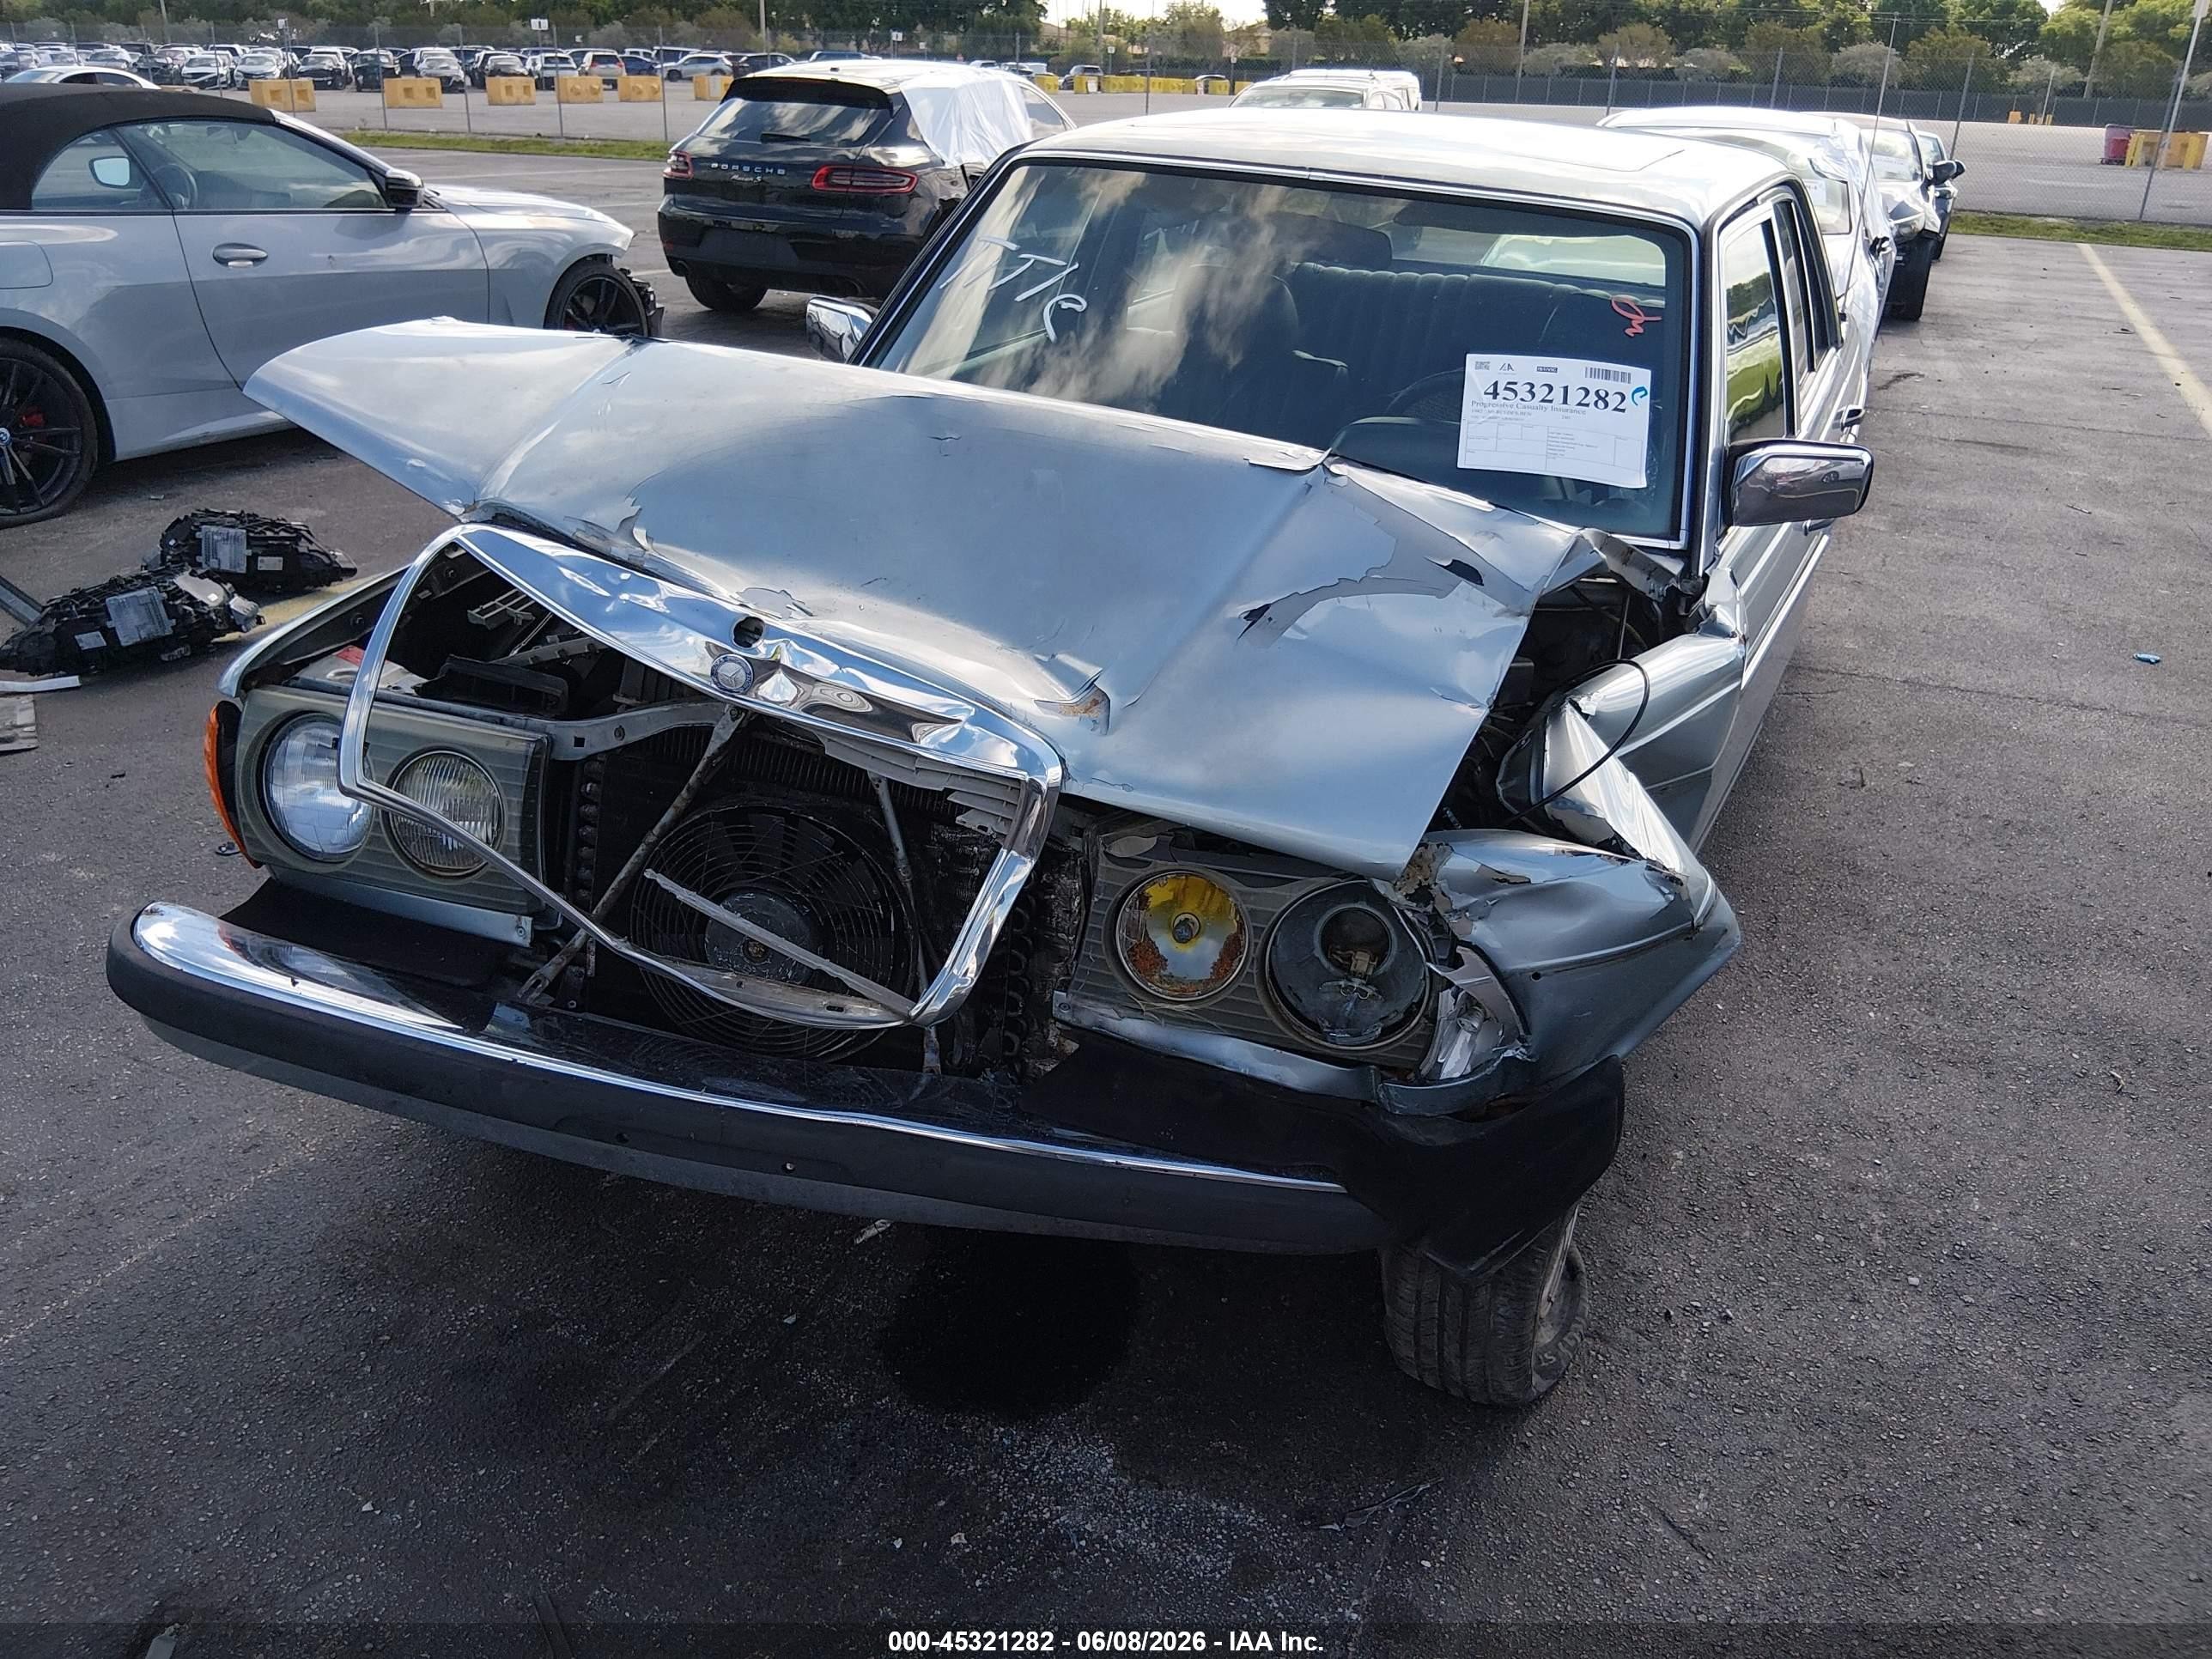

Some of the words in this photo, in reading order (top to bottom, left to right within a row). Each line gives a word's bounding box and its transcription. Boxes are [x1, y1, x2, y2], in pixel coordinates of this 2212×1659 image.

[711, 163, 786, 175] PORSCHE
[1483, 380, 1626, 414] 45321282
[1471, 400, 1514, 409] Progressive
[1516, 403, 1547, 412] Casualty
[1551, 405, 1587, 416] Insurance
